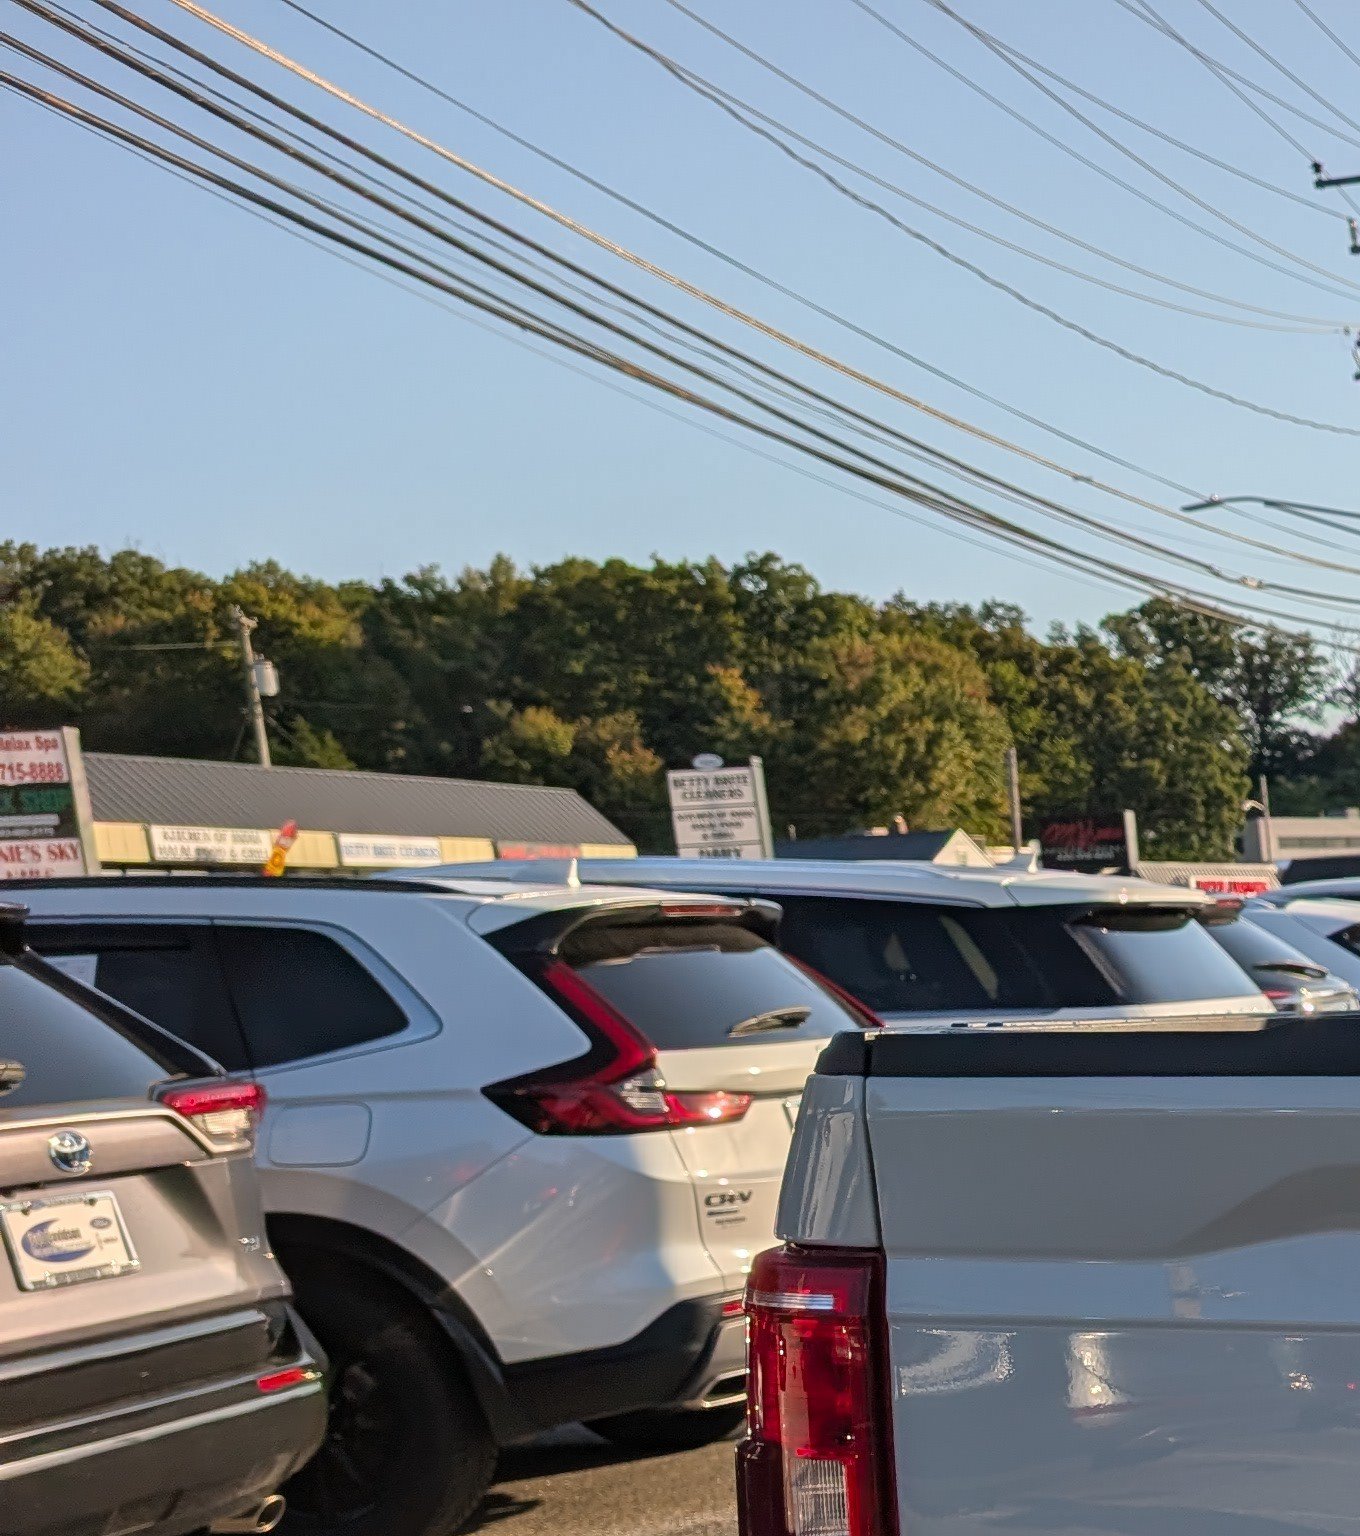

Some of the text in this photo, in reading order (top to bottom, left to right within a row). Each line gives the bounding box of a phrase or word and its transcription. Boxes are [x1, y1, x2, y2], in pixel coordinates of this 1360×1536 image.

[35, 735, 59, 752] Spa
[47, 843, 79, 861] SKY
[704, 1190, 753, 1206] CR-V
